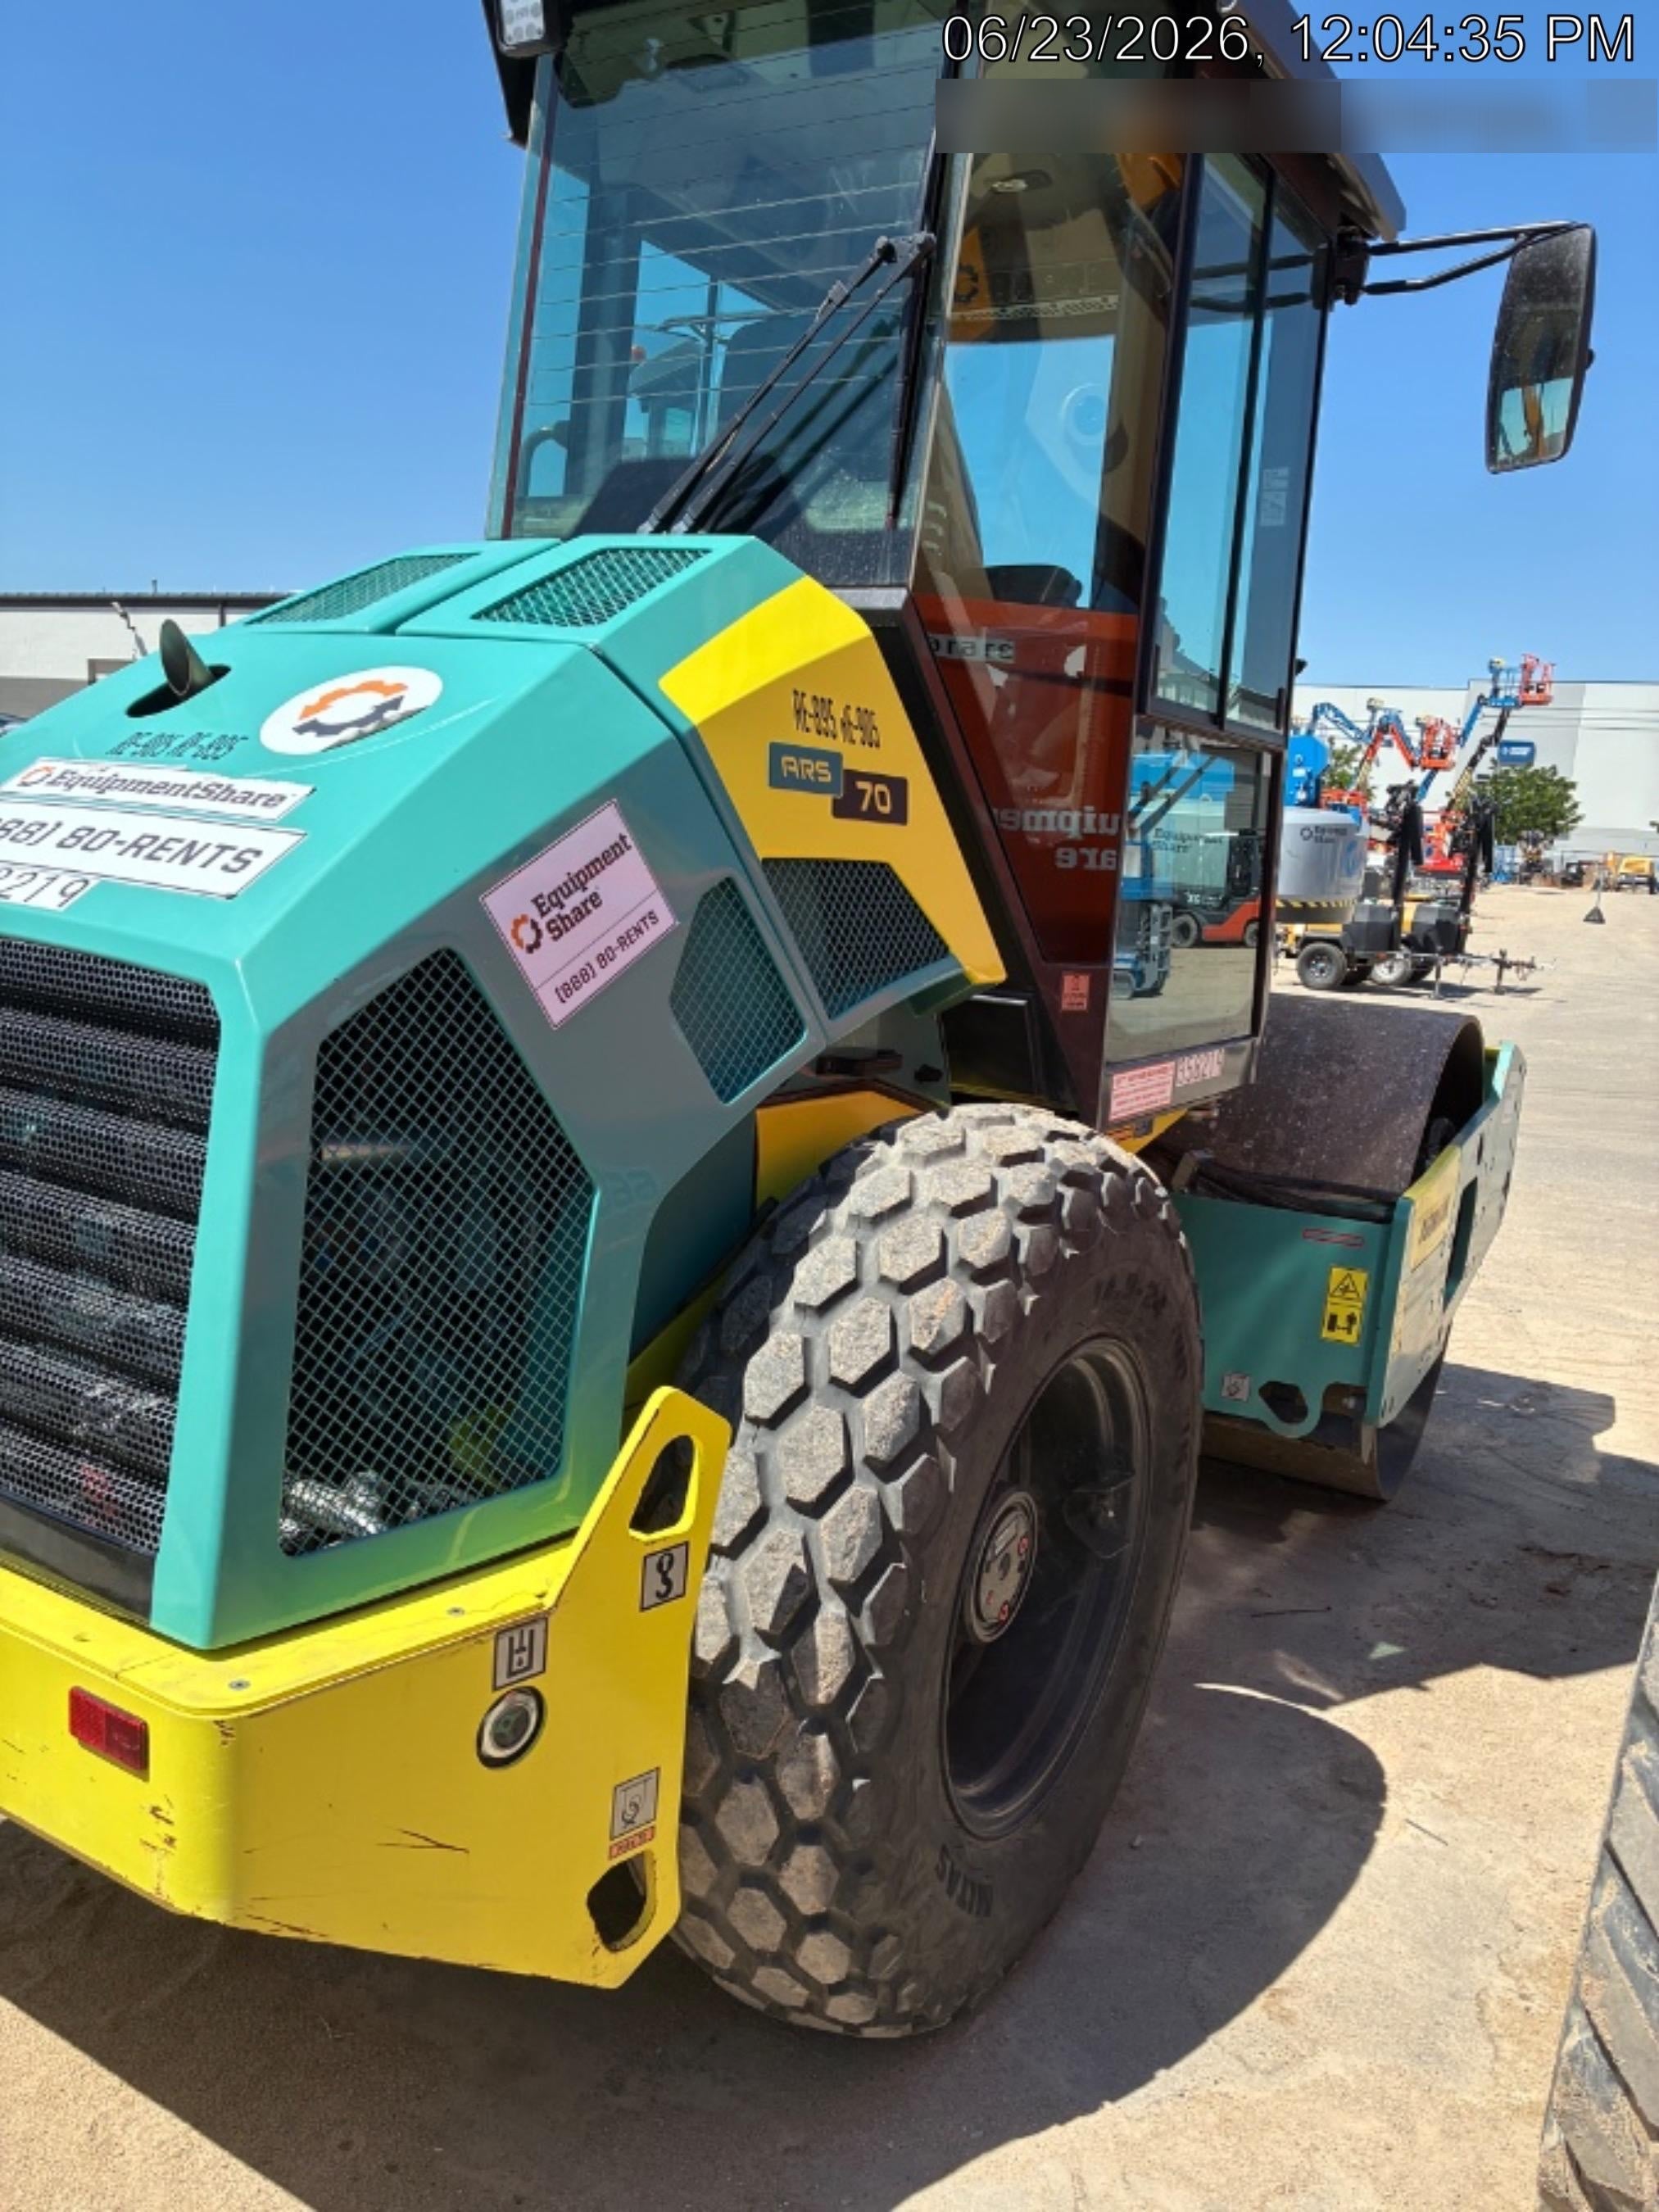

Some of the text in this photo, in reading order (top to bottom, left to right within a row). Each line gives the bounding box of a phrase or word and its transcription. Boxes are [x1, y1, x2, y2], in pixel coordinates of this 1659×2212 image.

[46, 768, 287, 809] EquipmentShare
[781, 755, 832, 783] ARS
[854, 780, 892, 814] 70
[56, 826, 264, 874] 80-RENTS
[529, 832, 632, 918] Equipment
[544, 887, 605, 943] Share
[553, 909, 660, 1004] (888) 80-RENTS
